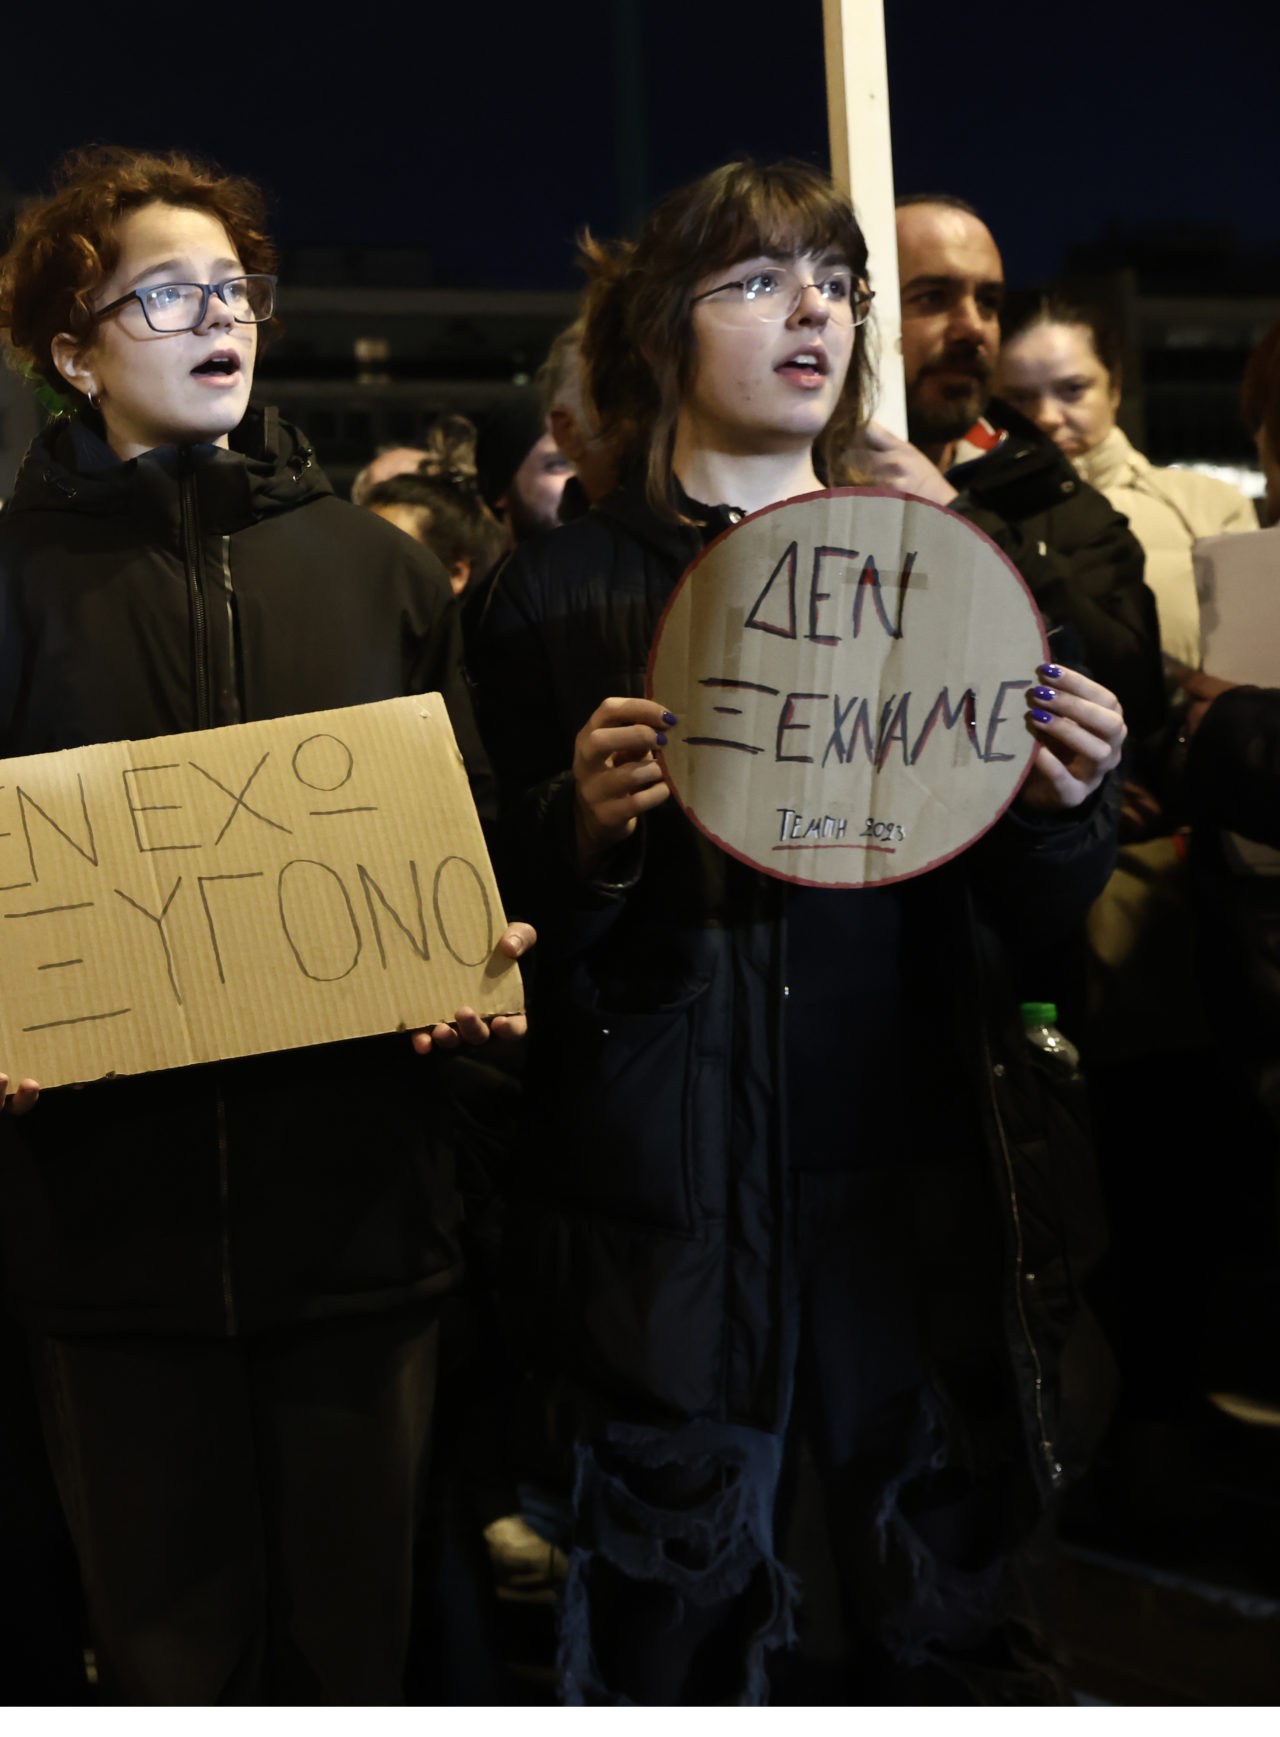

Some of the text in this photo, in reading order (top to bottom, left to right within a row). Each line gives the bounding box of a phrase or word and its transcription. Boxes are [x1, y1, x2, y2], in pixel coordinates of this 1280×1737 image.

[744, 541, 918, 646] ΔΕΝ
[682, 677, 1033, 774] ΞΕΧΝΑΜΕ
[776, 808, 905, 842] ΤΕΜΠΗ 2023
